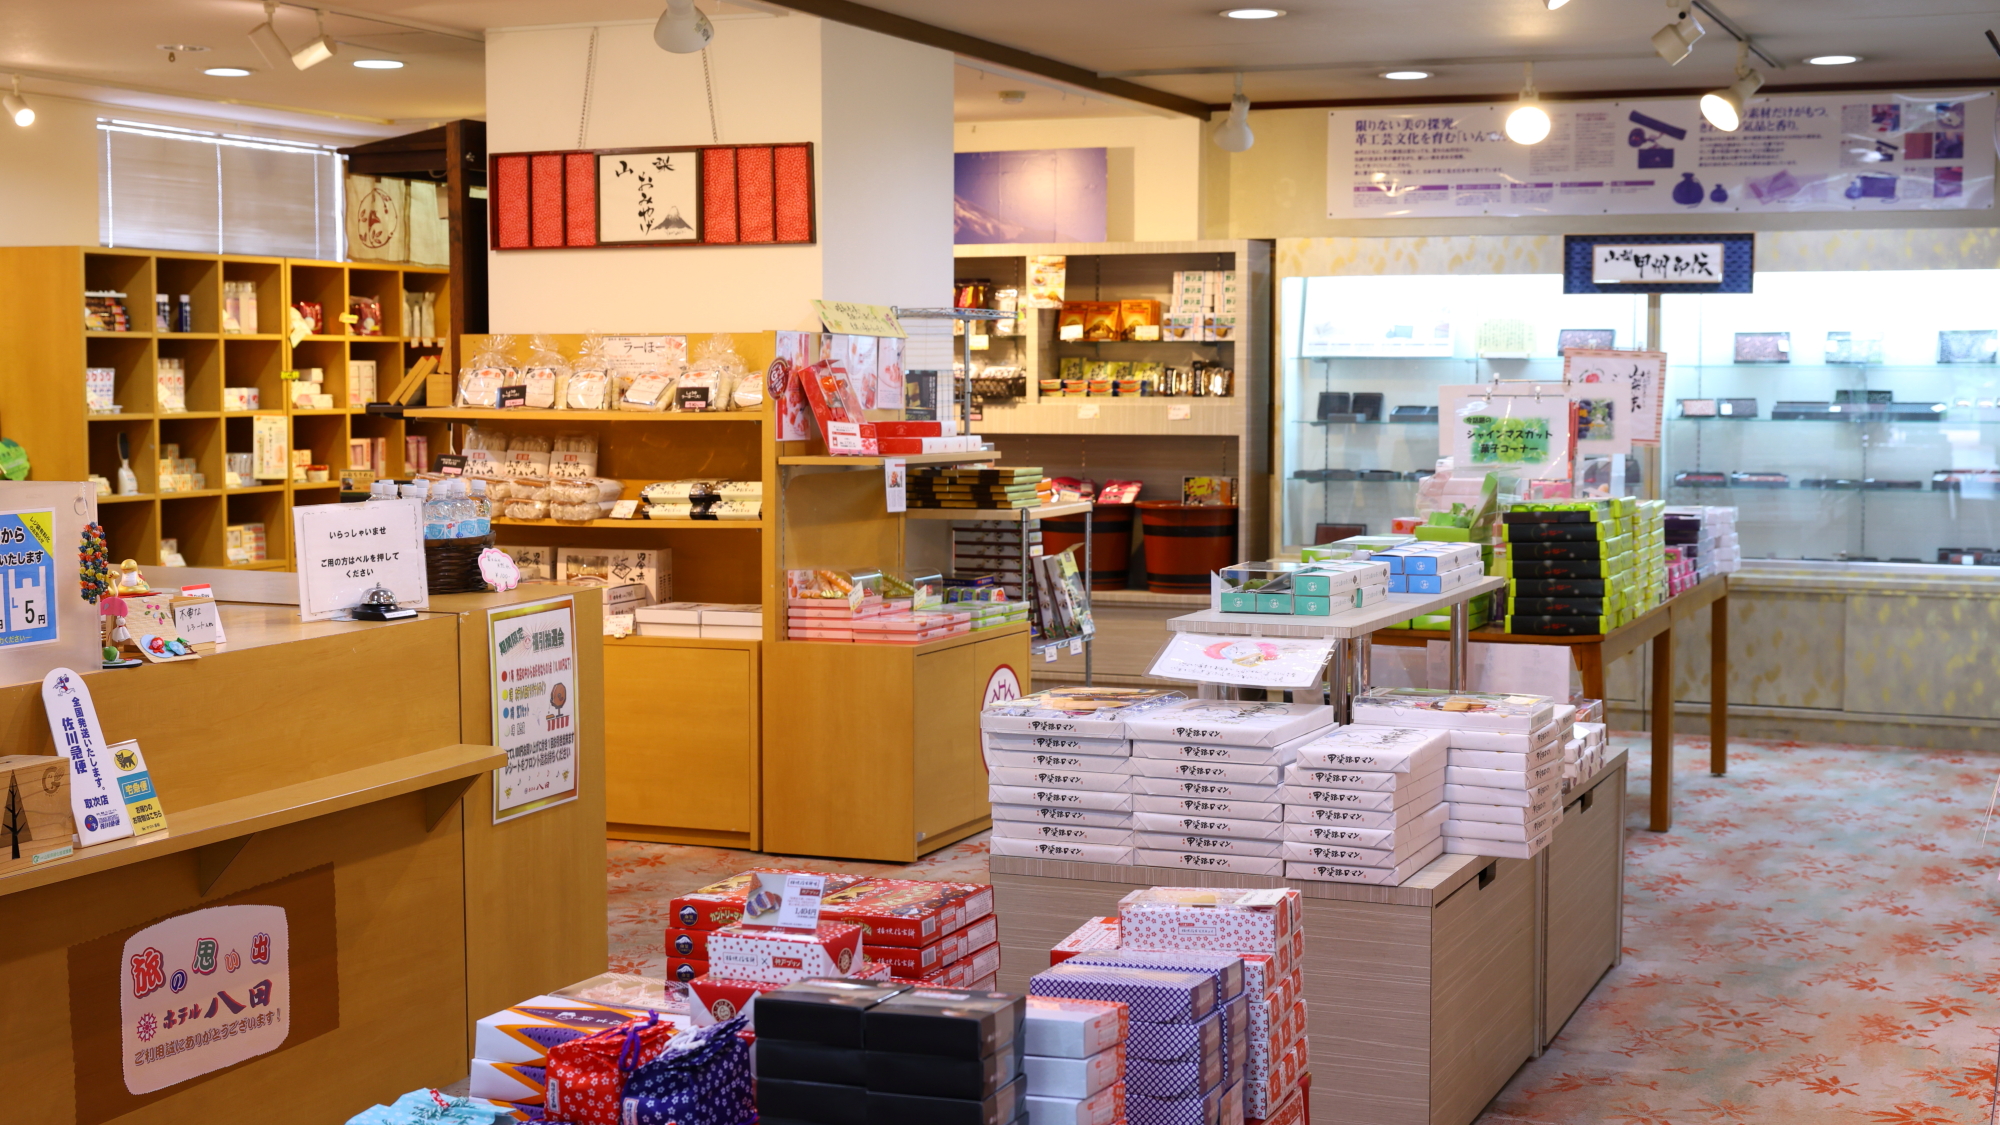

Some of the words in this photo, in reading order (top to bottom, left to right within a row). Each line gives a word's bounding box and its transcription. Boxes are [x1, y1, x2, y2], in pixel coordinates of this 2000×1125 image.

[624, 341, 666, 354] ラーほー
[1467, 430, 1553, 440] シャインマスカット
[1480, 444, 1538, 454] 菓子コーナー
[329, 526, 387, 539] いらっしゃいませ
[321, 552, 400, 568] ご用の方はベルを押して
[346, 568, 374, 578] ください
[12, 597, 18, 609] L
[62, 717, 88, 775] 佐川急便
[72, 697, 106, 790] 全国発送いたします。
[125, 780, 149, 796] 宅急便
[84, 795, 109, 809] 取次店
[131, 932, 271, 999] 旅の思い出
